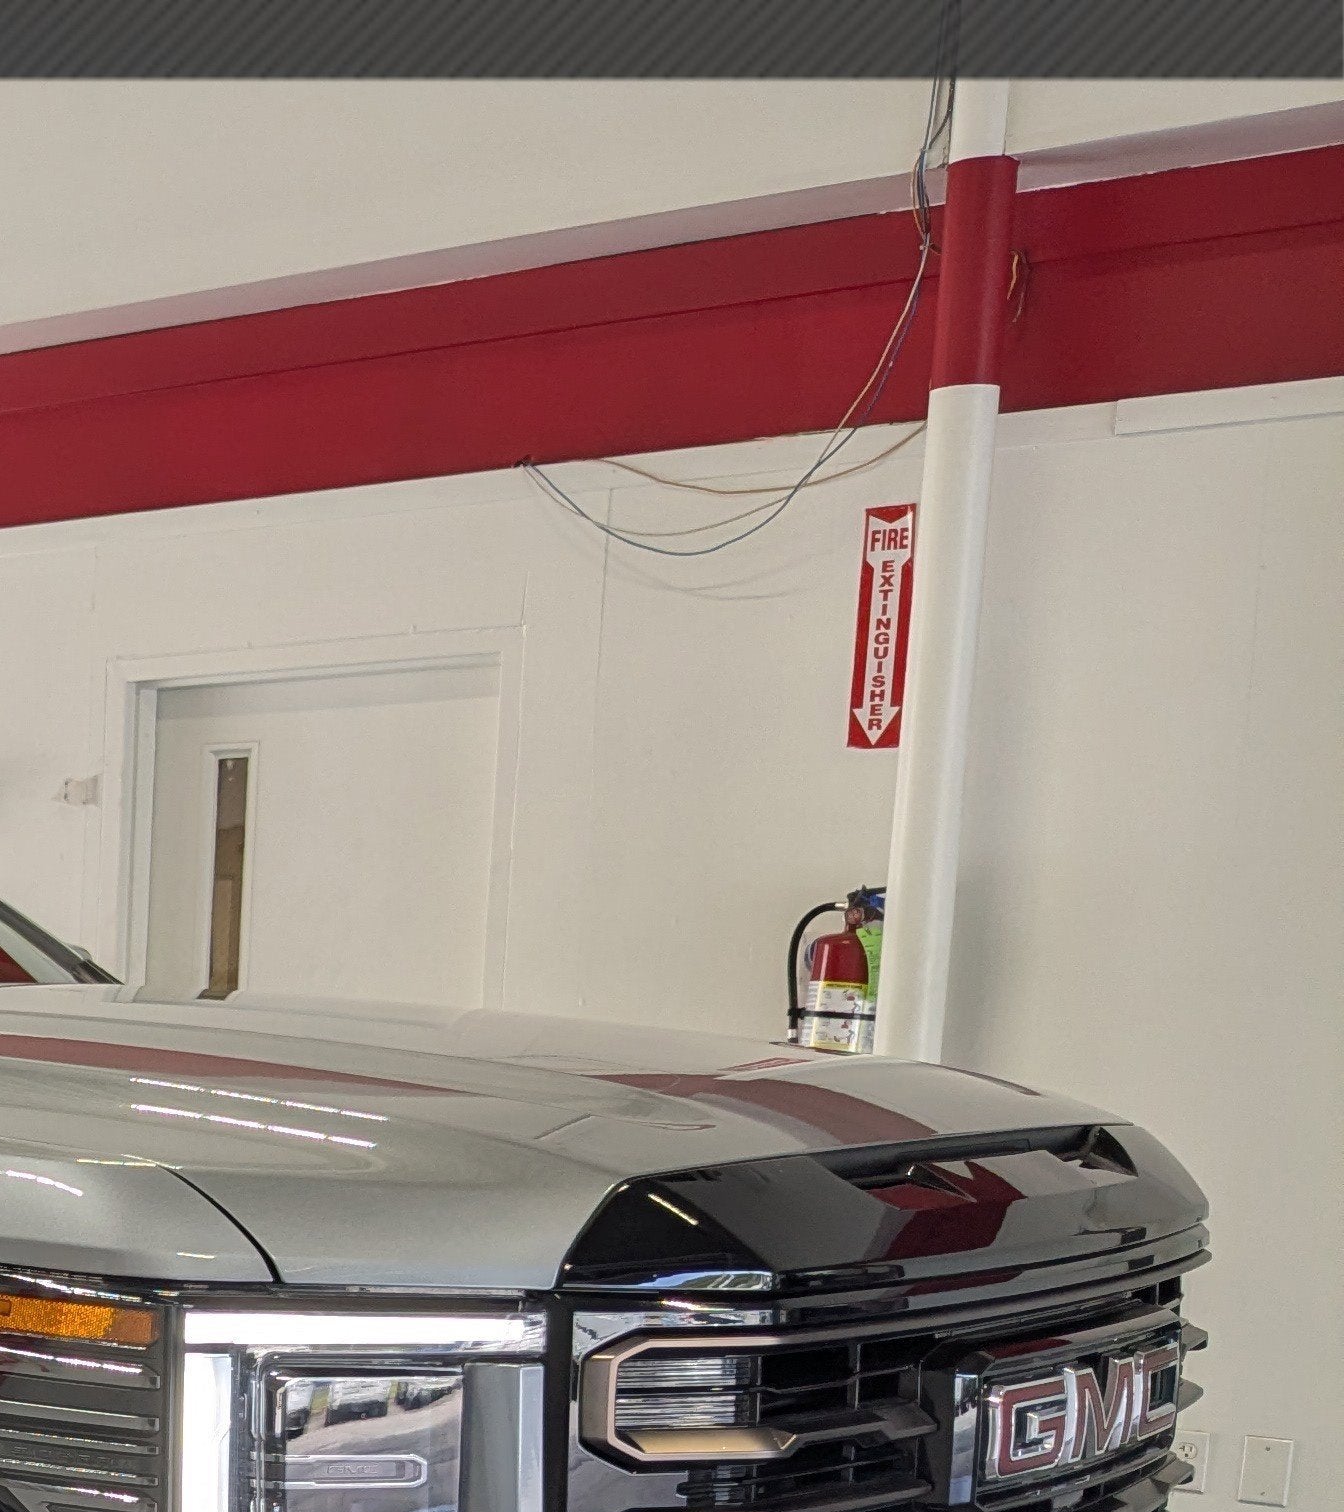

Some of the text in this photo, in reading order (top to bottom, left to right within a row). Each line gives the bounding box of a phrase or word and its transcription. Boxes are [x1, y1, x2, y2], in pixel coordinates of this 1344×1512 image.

[870, 527, 909, 552] FIRE
[868, 559, 895, 731] EXTINGUISHER
[985, 1340, 1180, 1480] GMC
